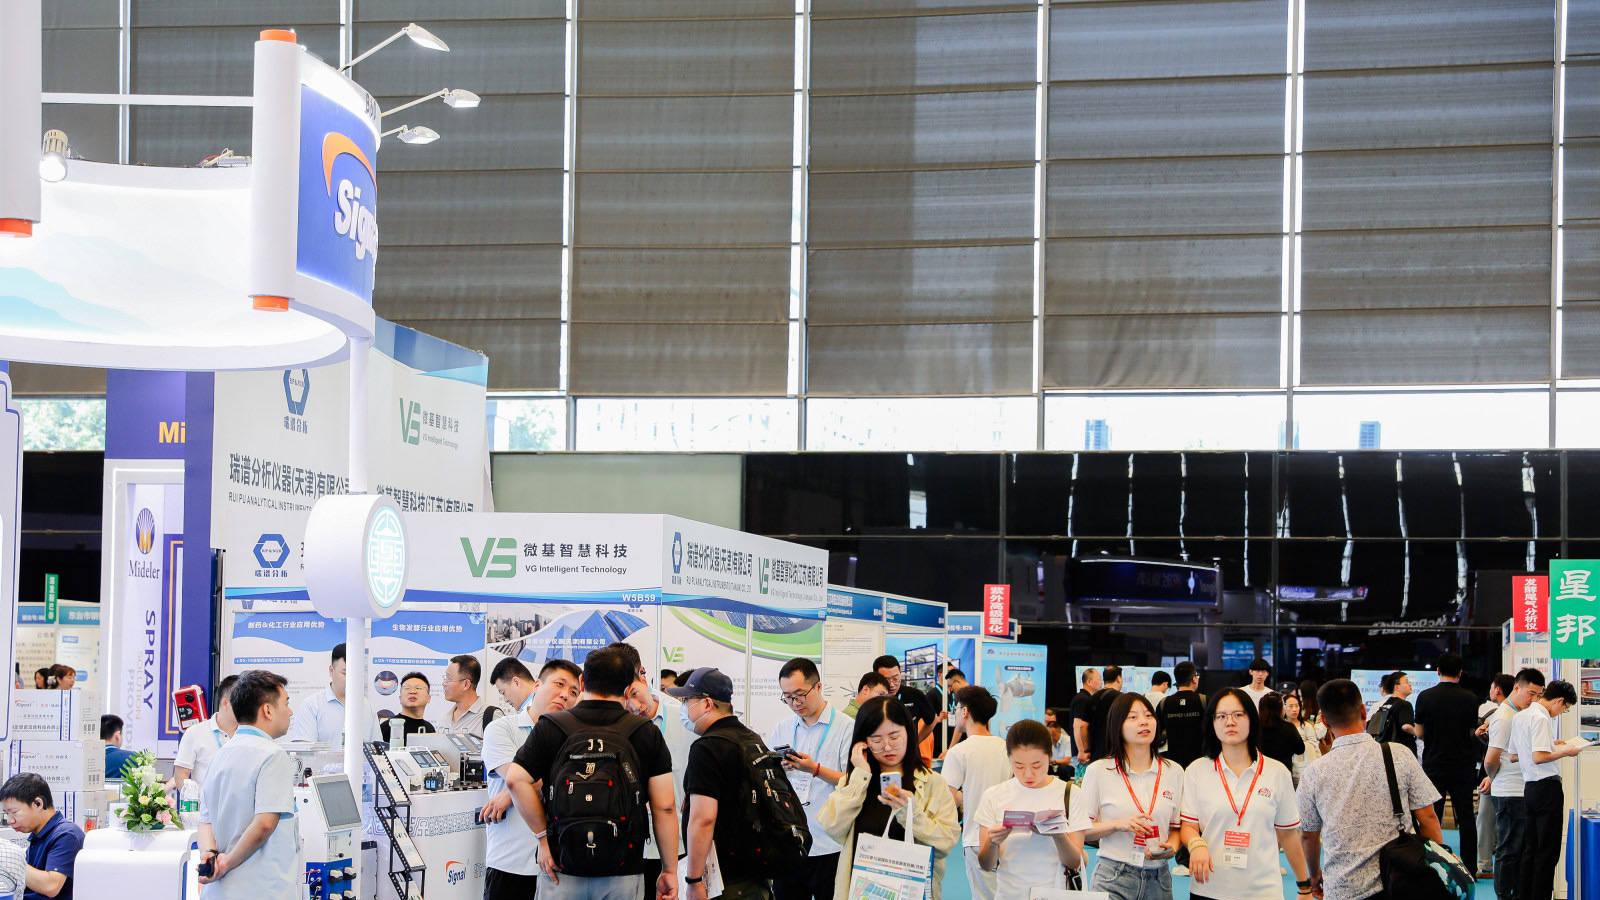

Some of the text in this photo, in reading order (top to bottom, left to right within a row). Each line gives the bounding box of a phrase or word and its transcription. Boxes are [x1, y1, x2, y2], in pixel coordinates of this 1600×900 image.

[523, 543, 628, 558] 微基智慧科技
[128, 560, 160, 579] Mideler
[525, 565, 627, 575] VG Intelligent Technology
[622, 594, 656, 602] W5B59
[989, 586, 1004, 633] 紫外高级氧化
[1524, 578, 1537, 630] 发酵尾气分析仪
[1555, 570, 1597, 646] 星邦
[143, 609, 156, 710] SPRAY
